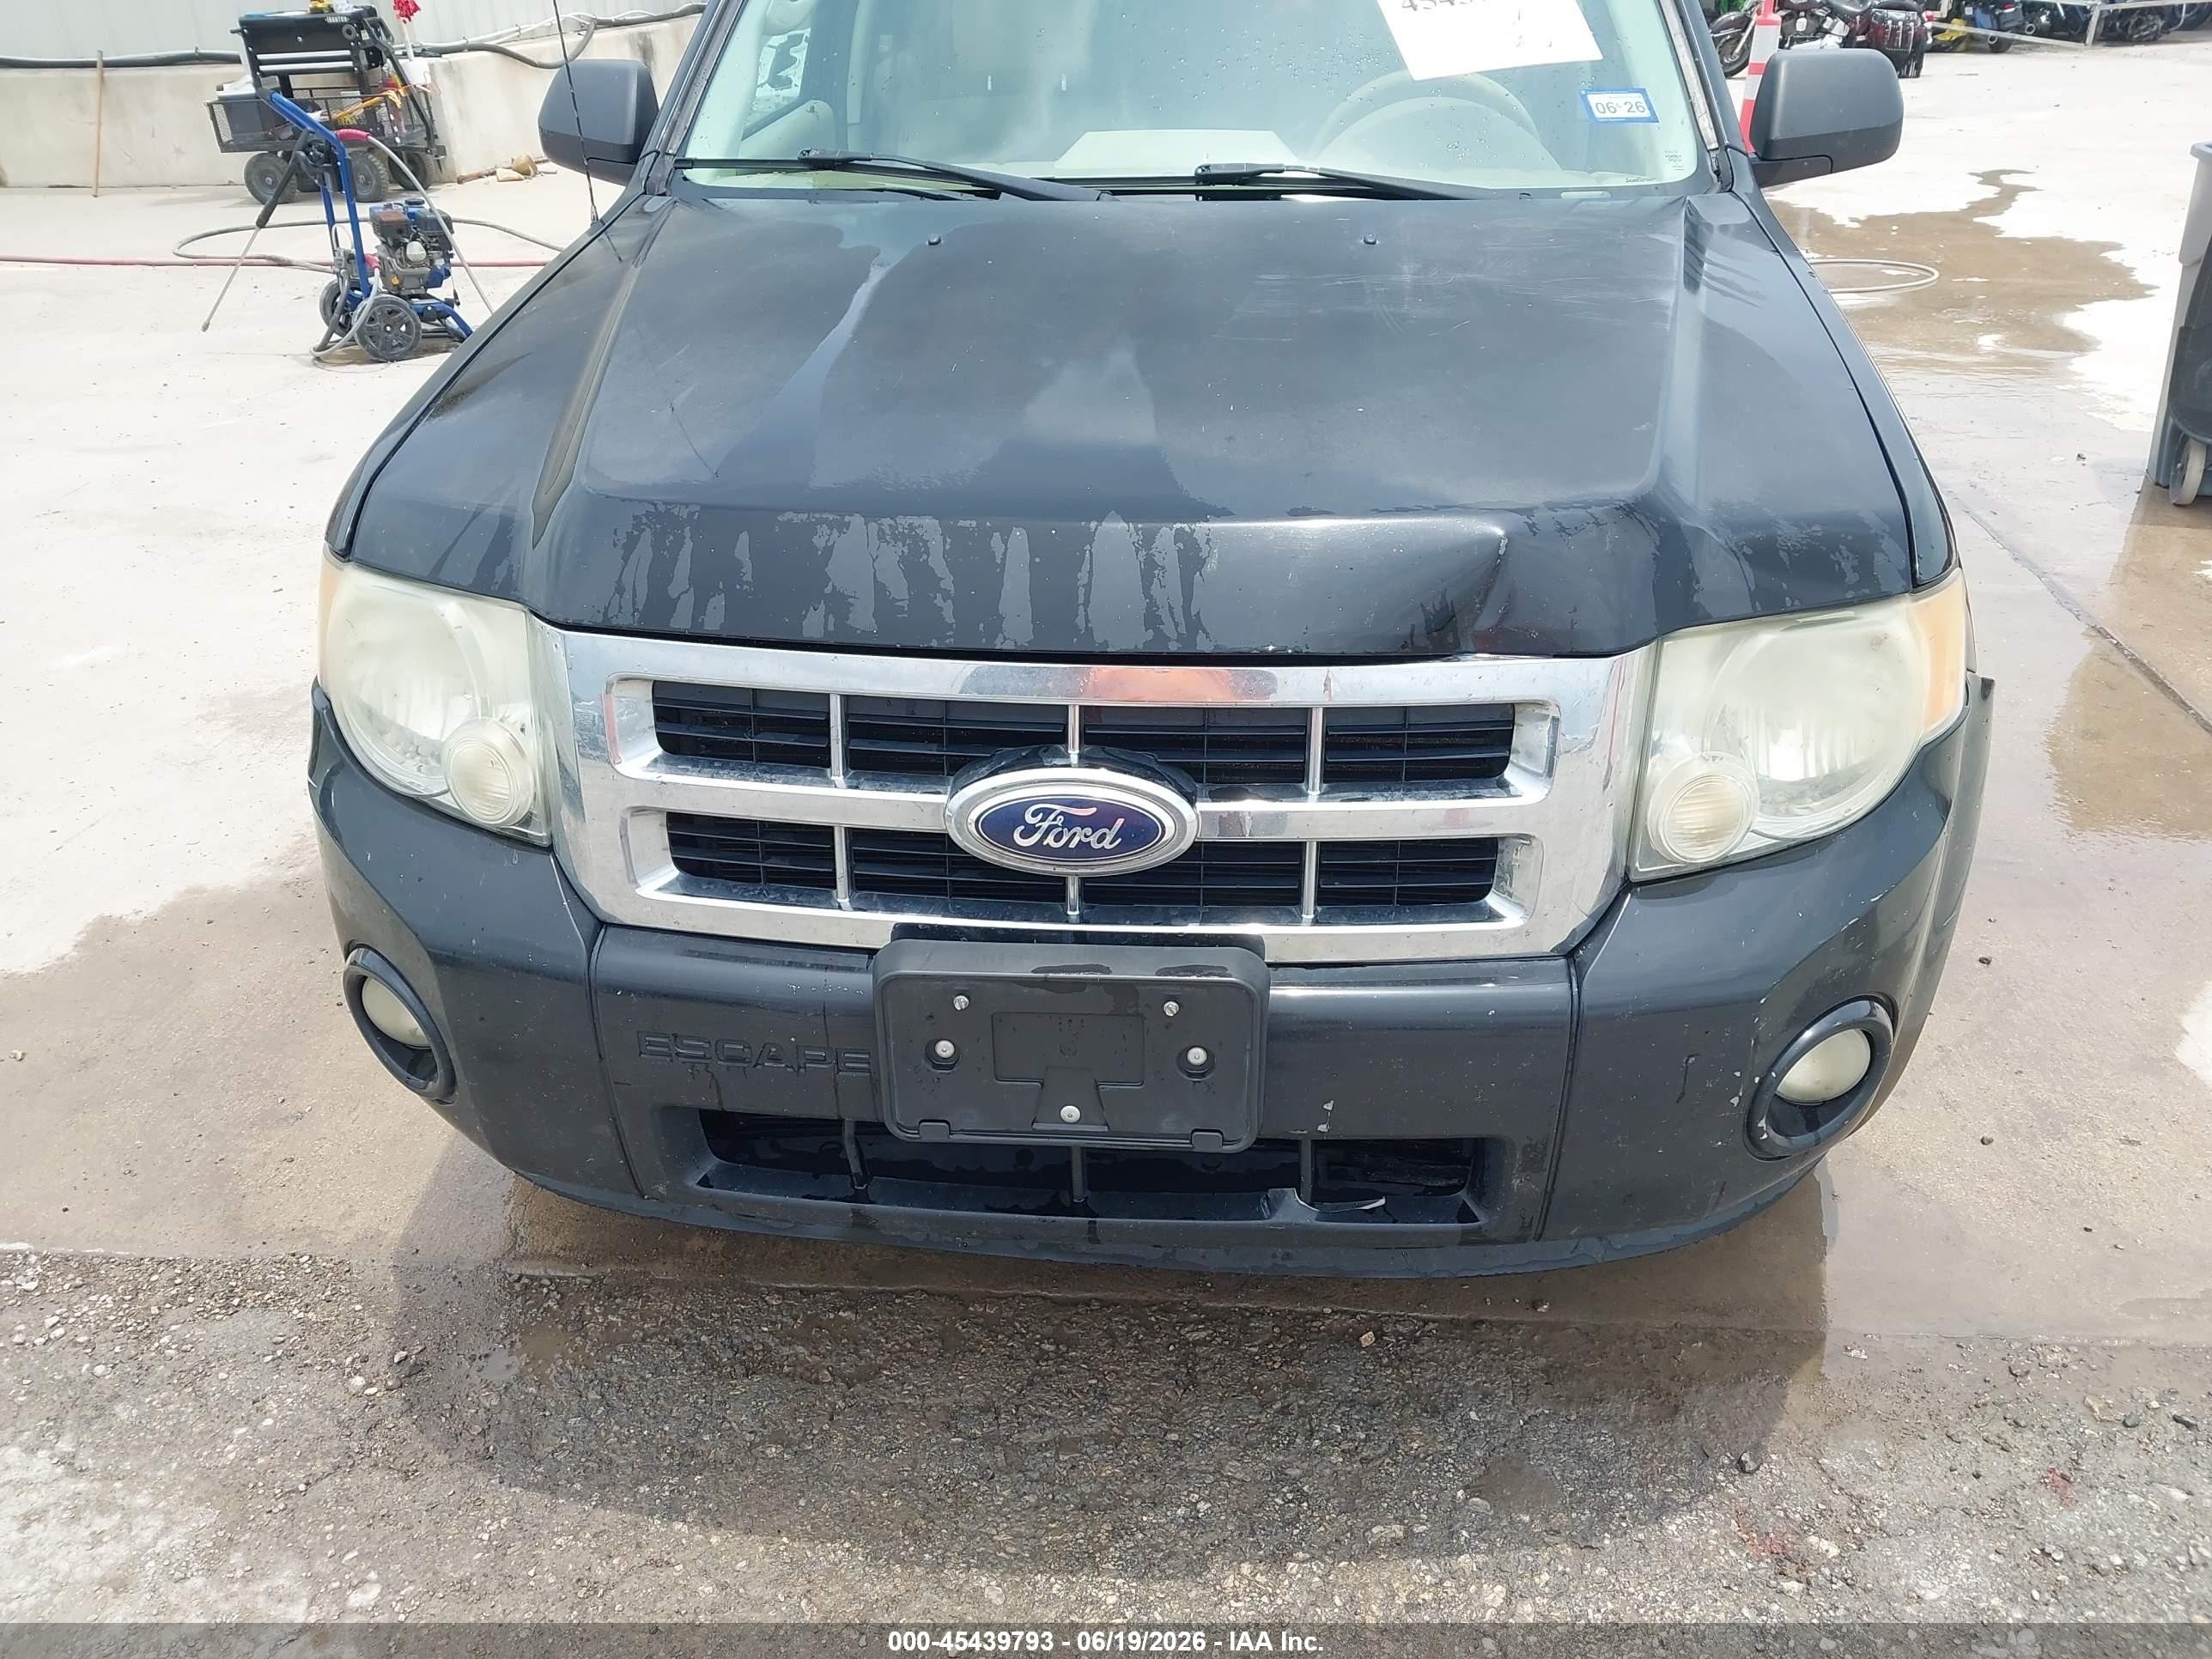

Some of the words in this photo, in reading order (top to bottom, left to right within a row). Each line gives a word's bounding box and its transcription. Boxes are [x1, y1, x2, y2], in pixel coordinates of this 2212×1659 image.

[1595, 102, 1618, 114] 06
[1624, 101, 1646, 113] 26
[1013, 803, 1125, 850] Ford
[636, 1030, 872, 1076] ESCAPE
